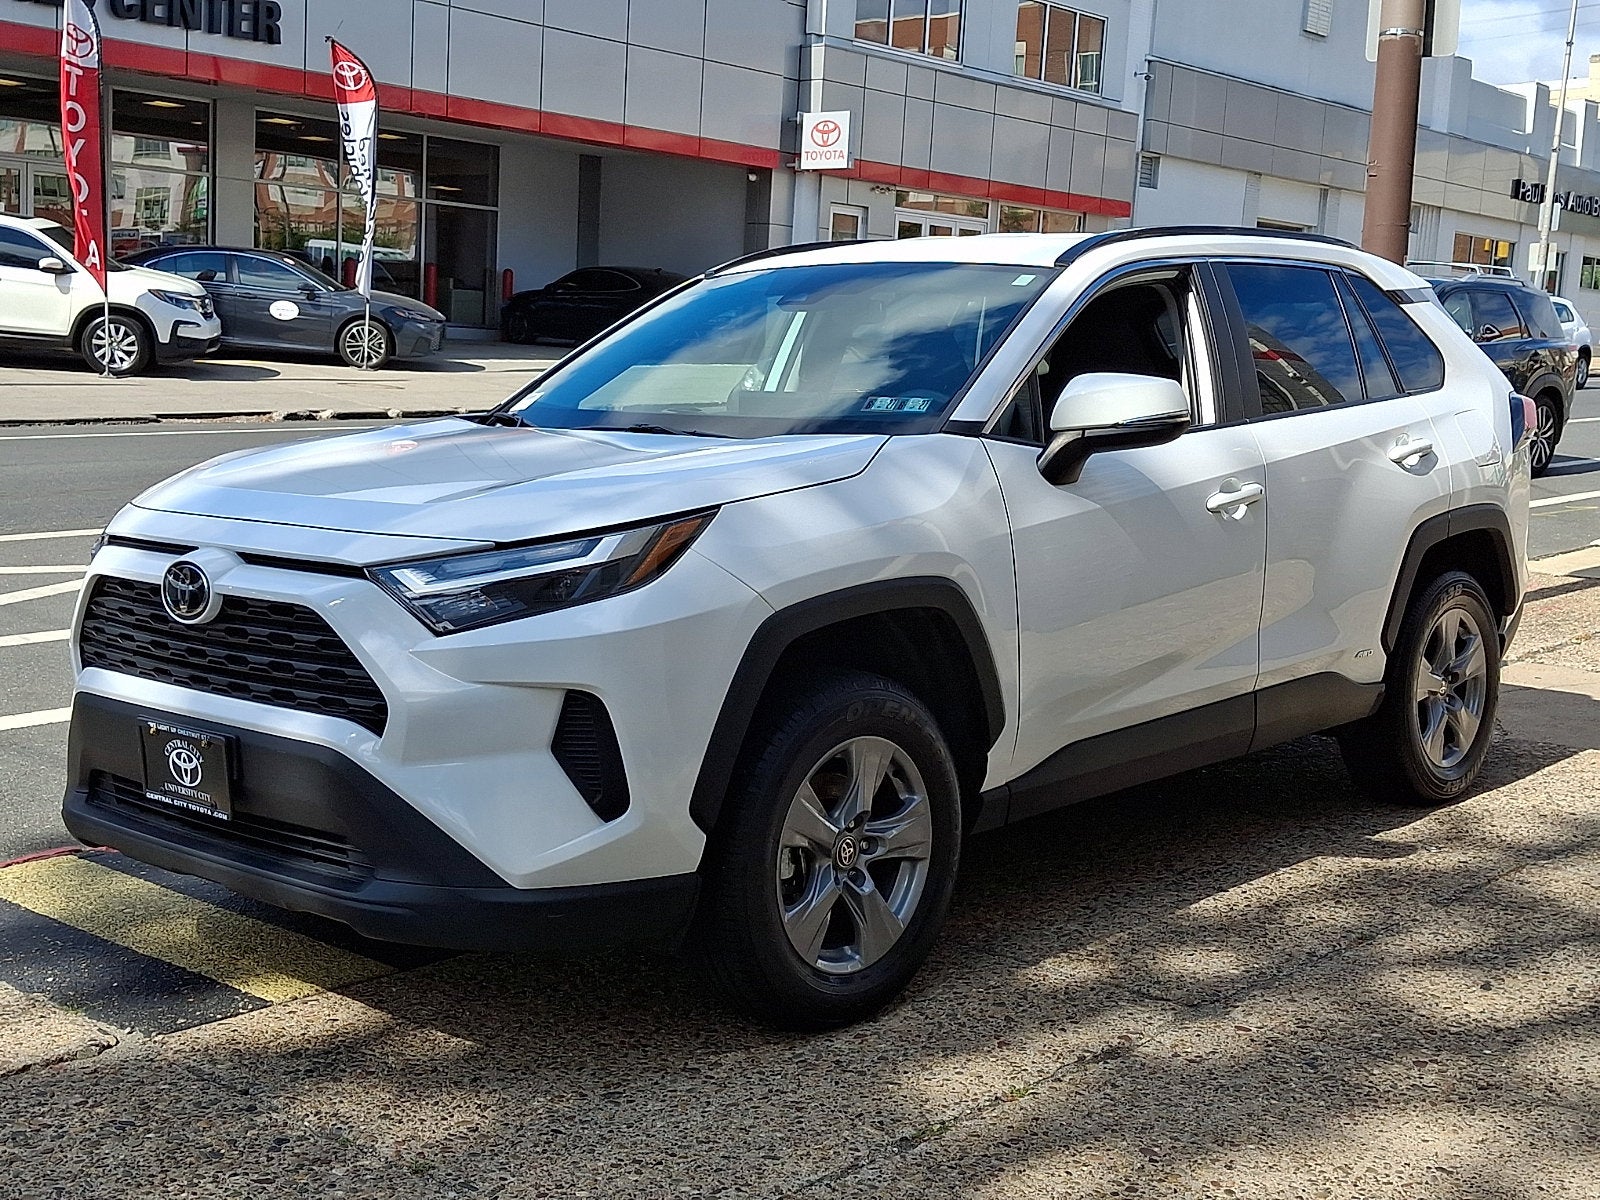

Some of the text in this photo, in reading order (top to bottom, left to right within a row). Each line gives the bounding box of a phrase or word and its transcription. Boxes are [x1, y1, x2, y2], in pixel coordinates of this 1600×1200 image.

[65, 64, 100, 271] TOYOA
[804, 150, 845, 161] TOYOTA
[1517, 179, 1541, 204] Paul
[164, 739, 205, 764] CENTRAL CITY
[145, 792, 173, 804] CENTRAL
[173, 799, 188, 808] CITY
[187, 803, 212, 816] TOYOTA
[164, 782, 211, 803] UNIVERSITY CITY
